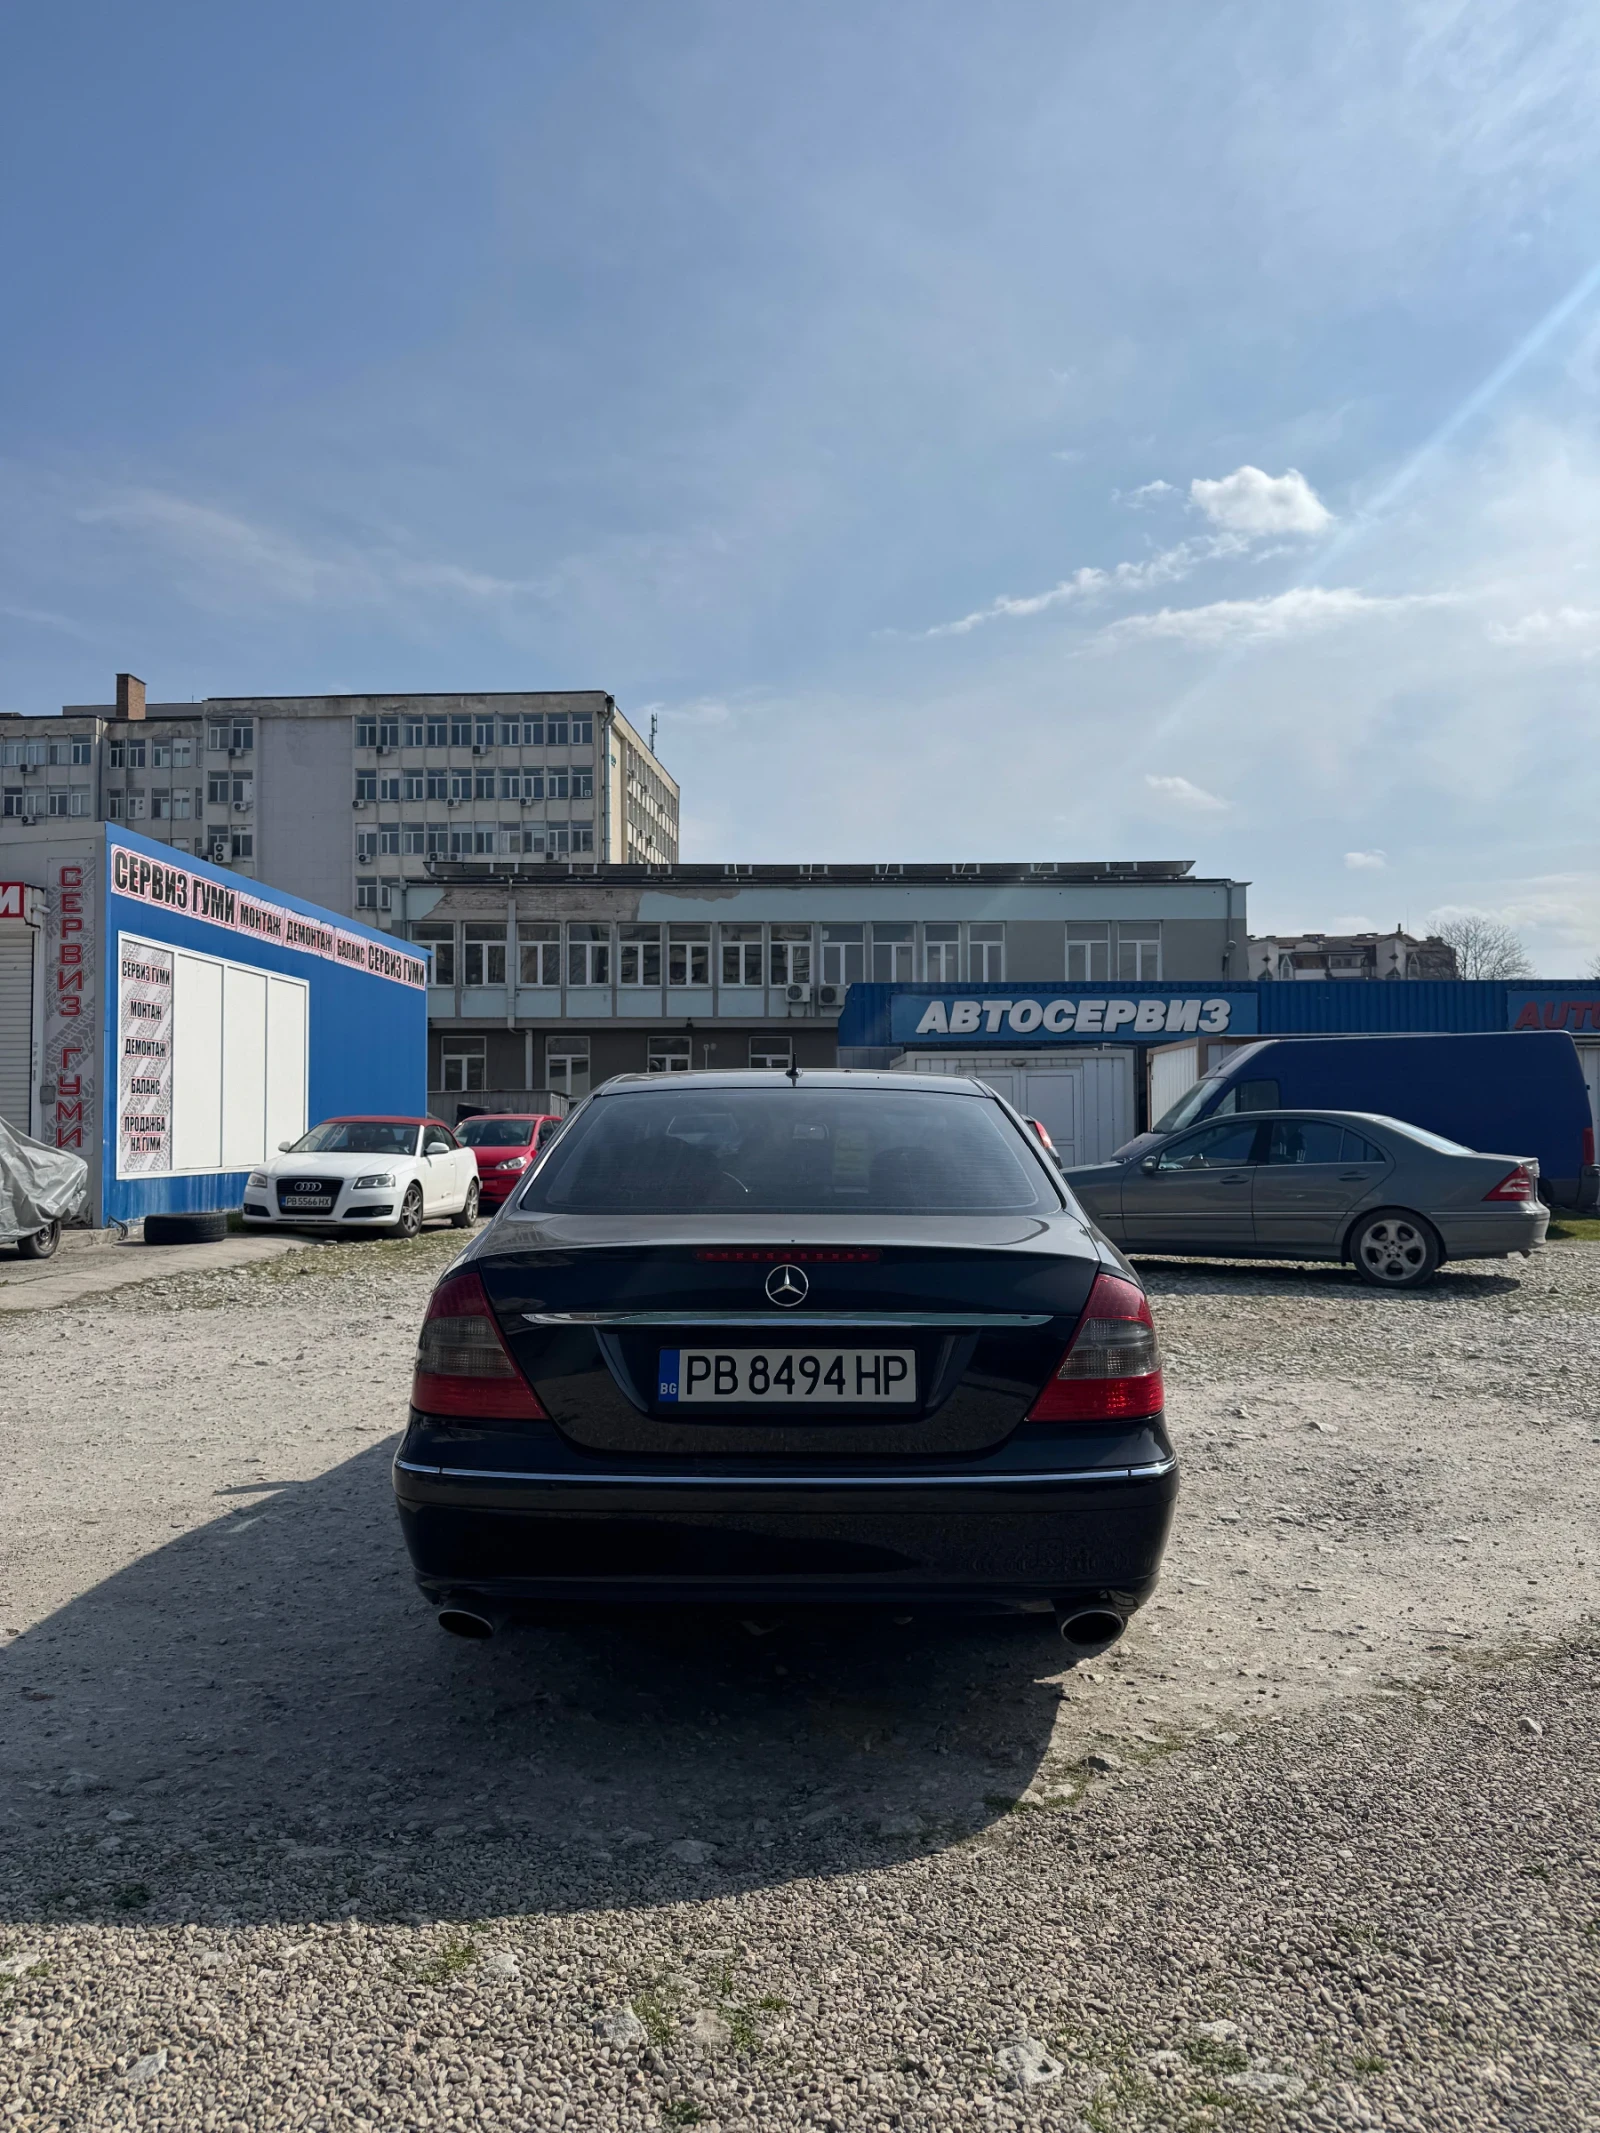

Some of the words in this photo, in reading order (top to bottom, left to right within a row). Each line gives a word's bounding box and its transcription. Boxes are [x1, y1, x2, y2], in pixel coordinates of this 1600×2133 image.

[114, 851, 188, 910] СЕРВИЗ
[192, 879, 235, 924] ГУМИ
[240, 903, 281, 937] МОНТАЖ
[286, 920, 333, 953] ДЕМОНТАЖ
[337, 938, 365, 965] БАЛАНС
[368, 945, 402, 979] СЕРВИЗ
[403, 958, 425, 987] ГУМИ
[57, 866, 84, 1017] СЕРВИЗ
[122, 961, 150, 981] СЕРВИЗ
[151, 967, 170, 985] ГУМИ
[130, 1001, 162, 1020] МОНТАЖ
[915, 999, 1232, 1034] АВТОСЕРВИЗ
[125, 1039, 167, 1058] ДЕМОНТАЖ
[131, 1078, 160, 1095] БАЛАНС
[56, 1047, 83, 1148] ГУМИ
[124, 1116, 166, 1133] ПРОДАЖБА
[130, 1137, 141, 1151] НА
[142, 1136, 161, 1151] ГУМИ
[686, 1355, 739, 1395] PB
[748, 1355, 846, 1395] 8494
[855, 1355, 908, 1395] HP
[660, 1383, 677, 1395] BG
